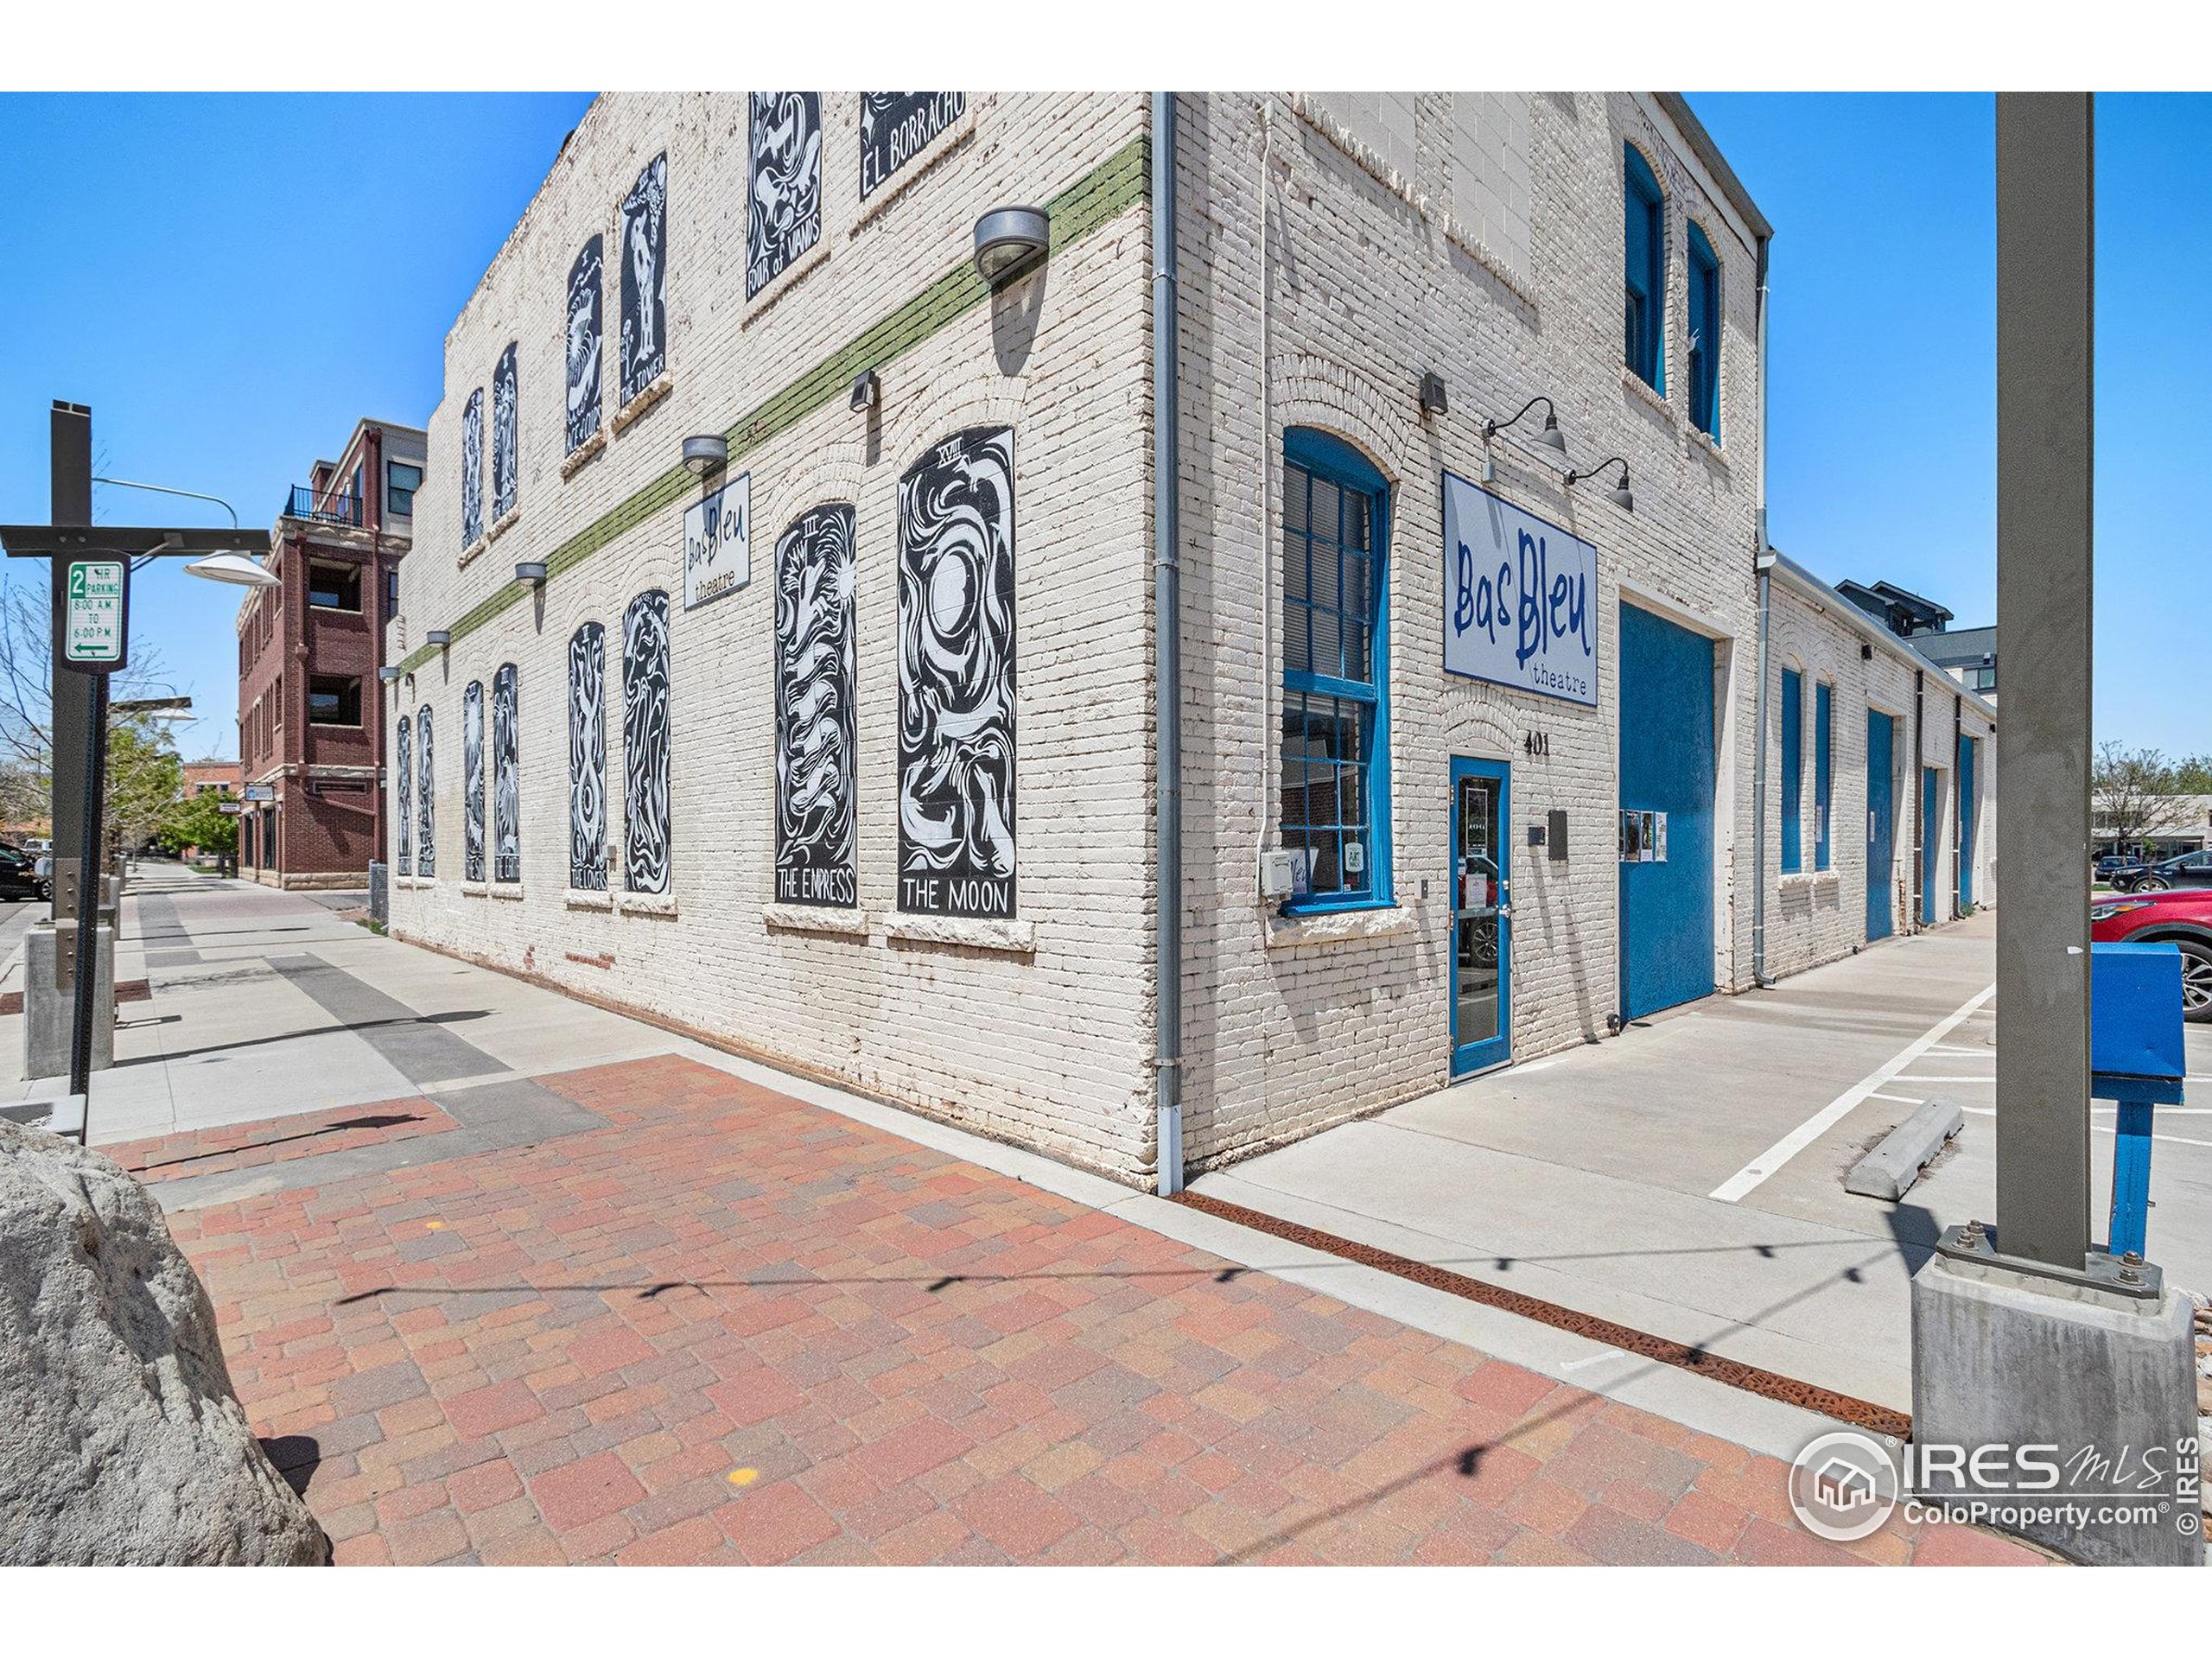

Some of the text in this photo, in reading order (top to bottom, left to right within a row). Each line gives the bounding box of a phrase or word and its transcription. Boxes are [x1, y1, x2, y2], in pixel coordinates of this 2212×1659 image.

[863, 92, 964, 196] EL BORRACHO
[748, 257, 769, 297] FOUR
[787, 213, 819, 261] WANDS
[620, 353, 664, 406] THE TOWER
[689, 498, 745, 574] Bas Bleu
[73, 569, 85, 594] 2
[87, 583, 119, 594] PARKING
[97, 568, 111, 580] HR
[695, 569, 734, 601] theatre
[74, 600, 93, 610] 8:00
[1454, 527, 1591, 671] Bas Bleu
[74, 627, 94, 638] 6:00
[89, 613, 99, 624] TO
[1533, 662, 1586, 696] theatre
[1524, 730, 1549, 756] 401
[571, 868, 583, 888] THE
[779, 867, 855, 904] THE EMPRESS
[903, 878, 1008, 913] THE MOON
